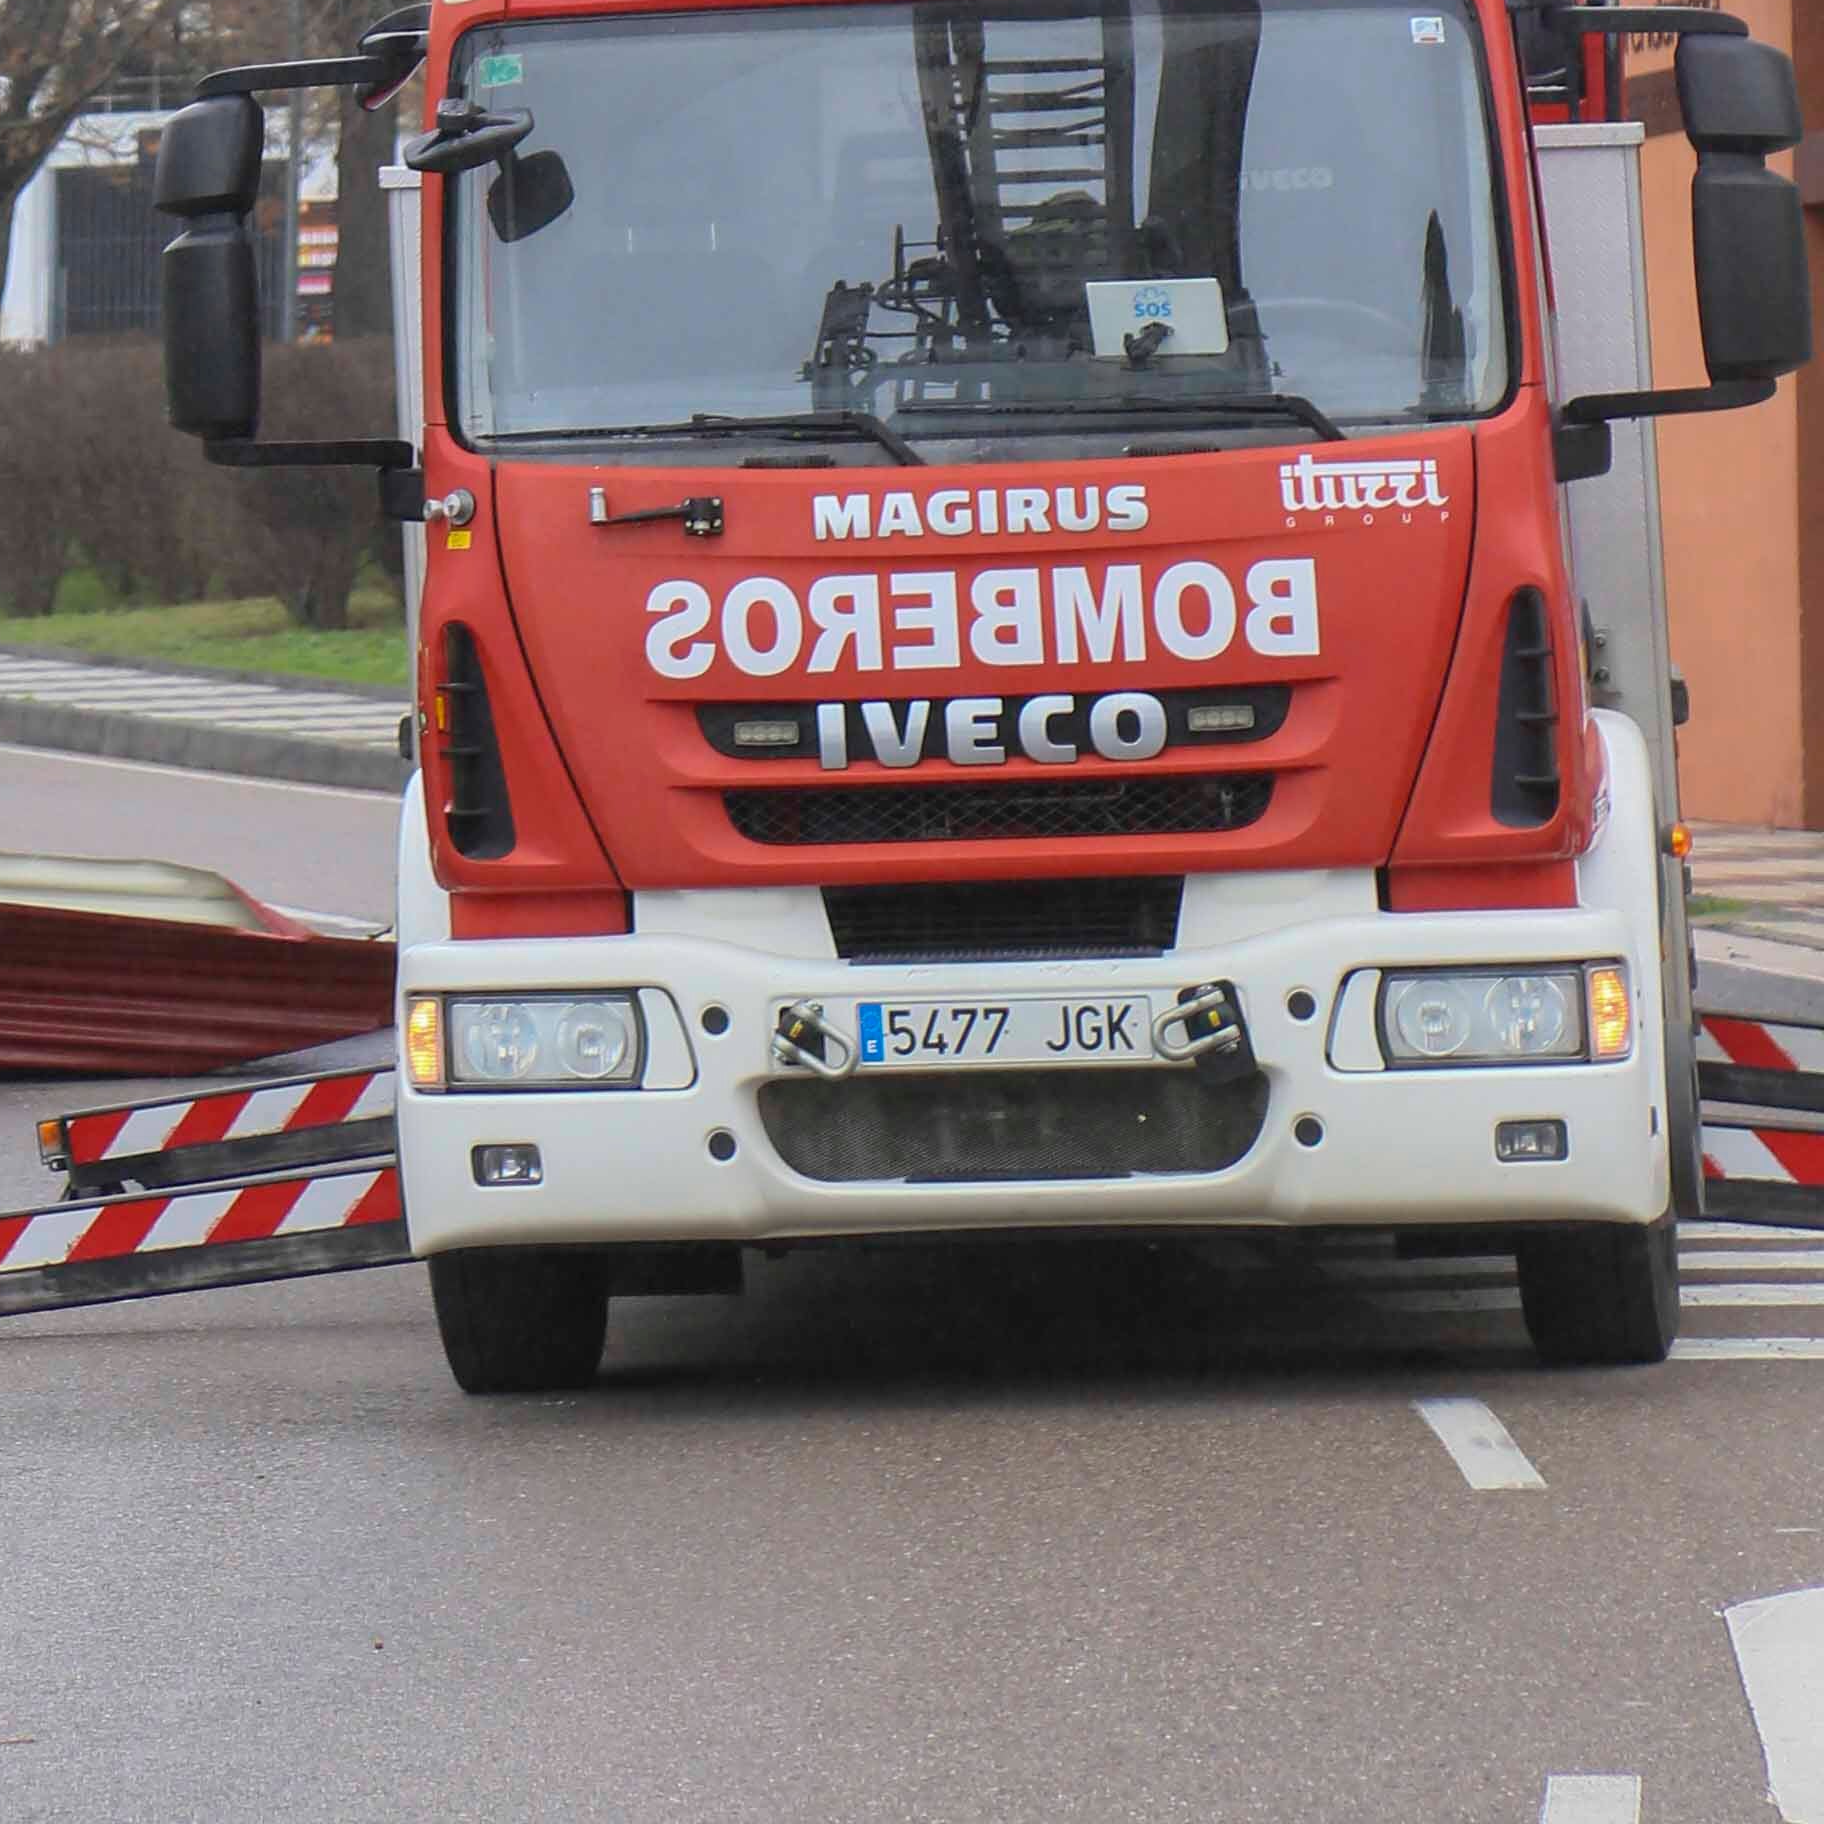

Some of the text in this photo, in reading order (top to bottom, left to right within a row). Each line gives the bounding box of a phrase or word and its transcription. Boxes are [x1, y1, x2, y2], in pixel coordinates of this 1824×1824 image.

[1135, 303, 1171, 318] SOS
[812, 485, 1149, 541] MAGIRUS
[1285, 511, 1449, 528] GROUP
[816, 692, 1168, 770] IVECO
[887, 1007, 1009, 1055] 5477
[1045, 1004, 1134, 1052] JGK
